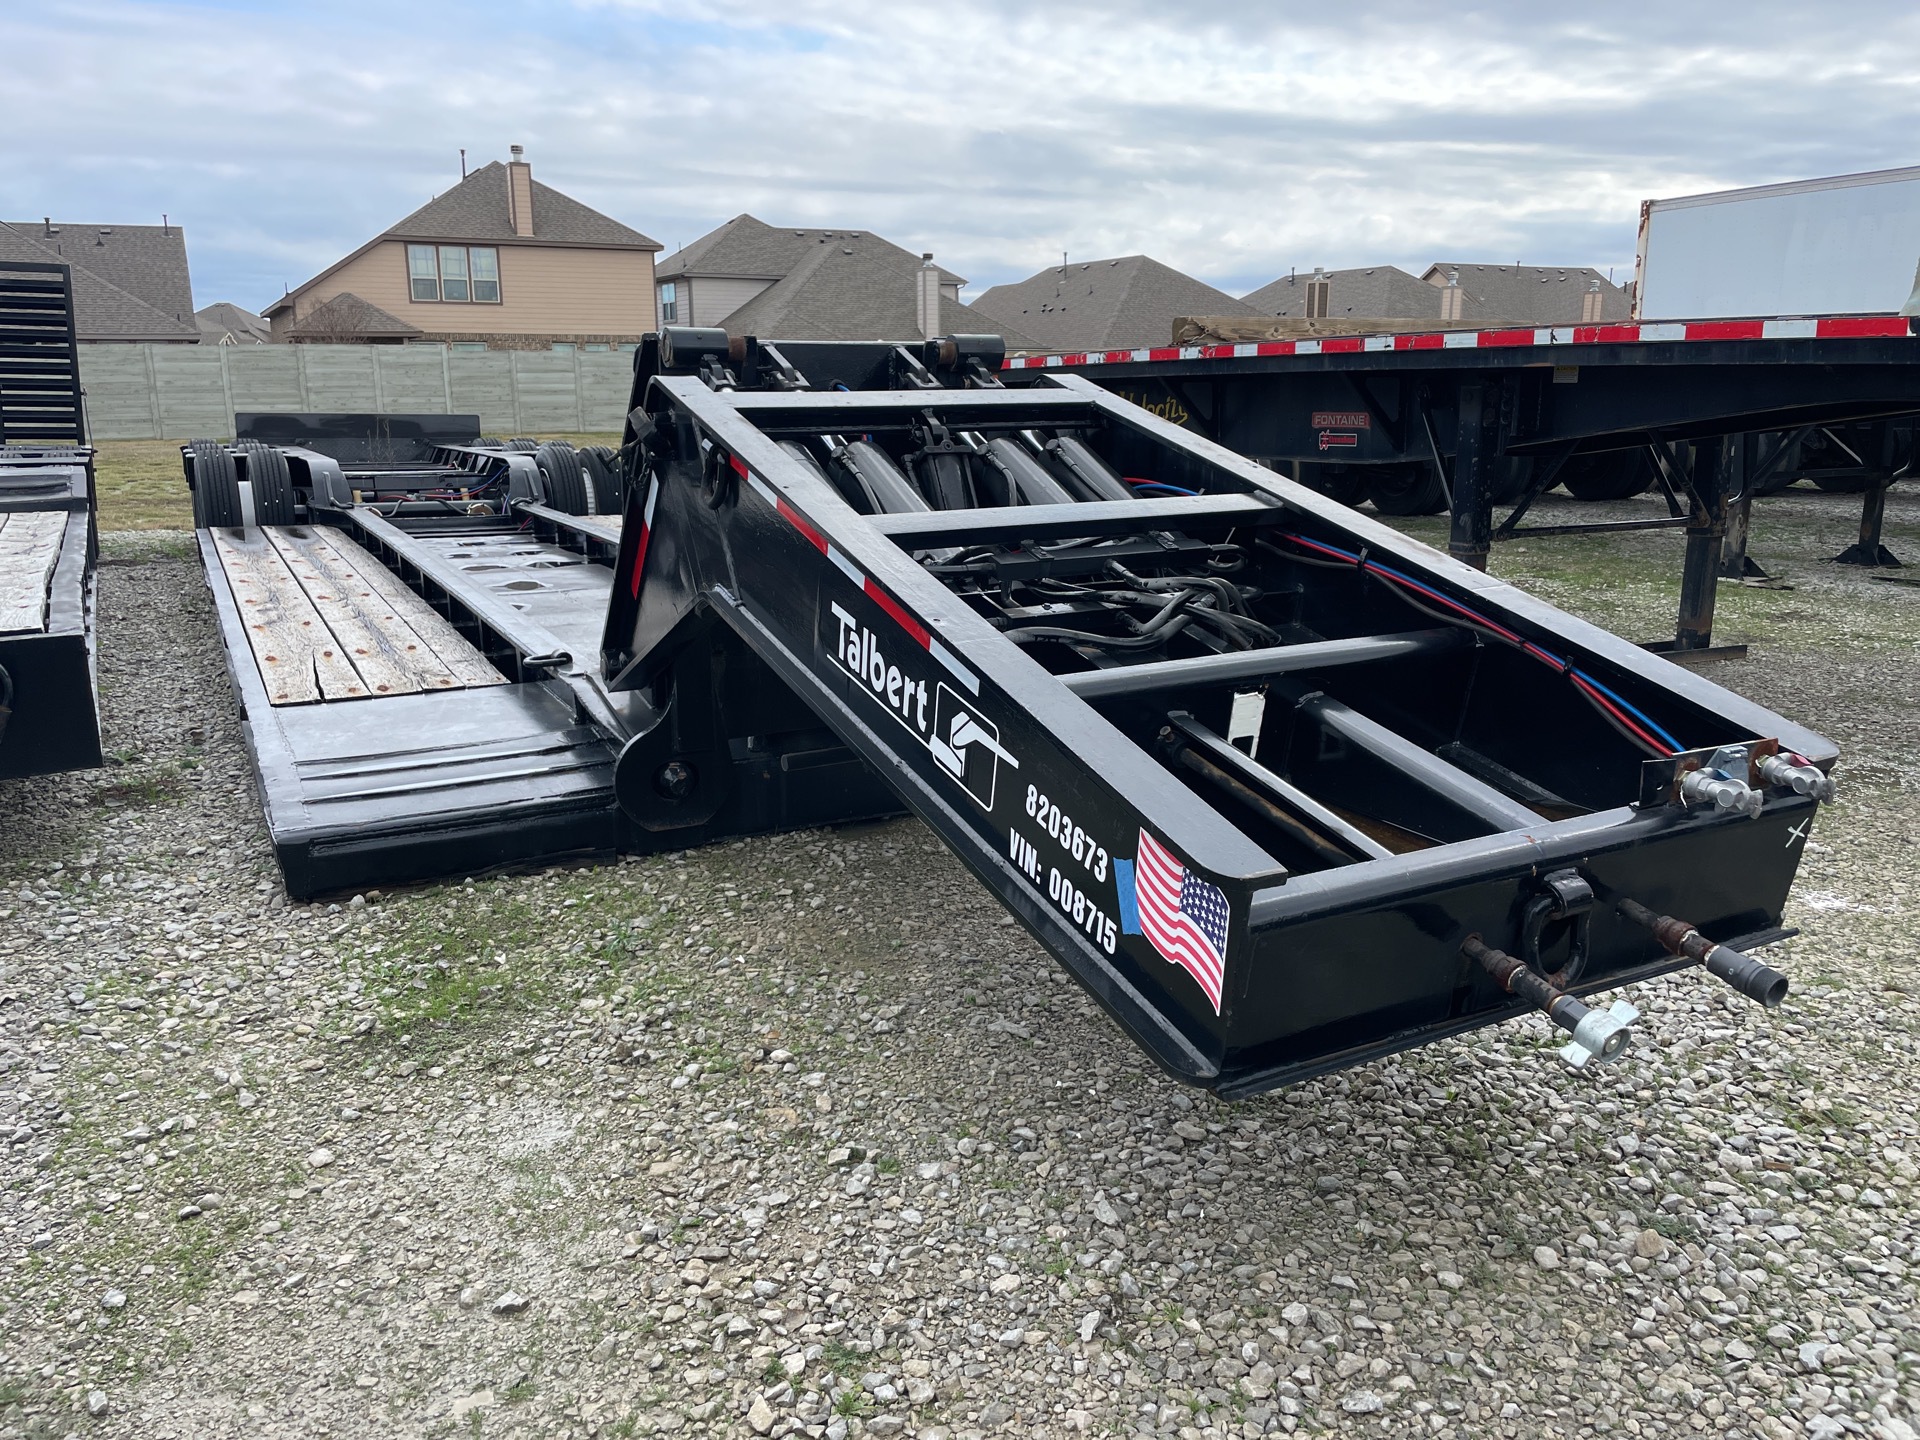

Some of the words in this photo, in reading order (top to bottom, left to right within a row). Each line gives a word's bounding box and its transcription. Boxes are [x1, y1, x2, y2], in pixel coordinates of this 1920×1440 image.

[1315, 415, 1365, 426] FONTAINE
[831, 600, 930, 733] Talbert
[1009, 826, 1042, 886] VIN:
[1047, 867, 1119, 956] 008715
[1025, 783, 1109, 884] 8203673
